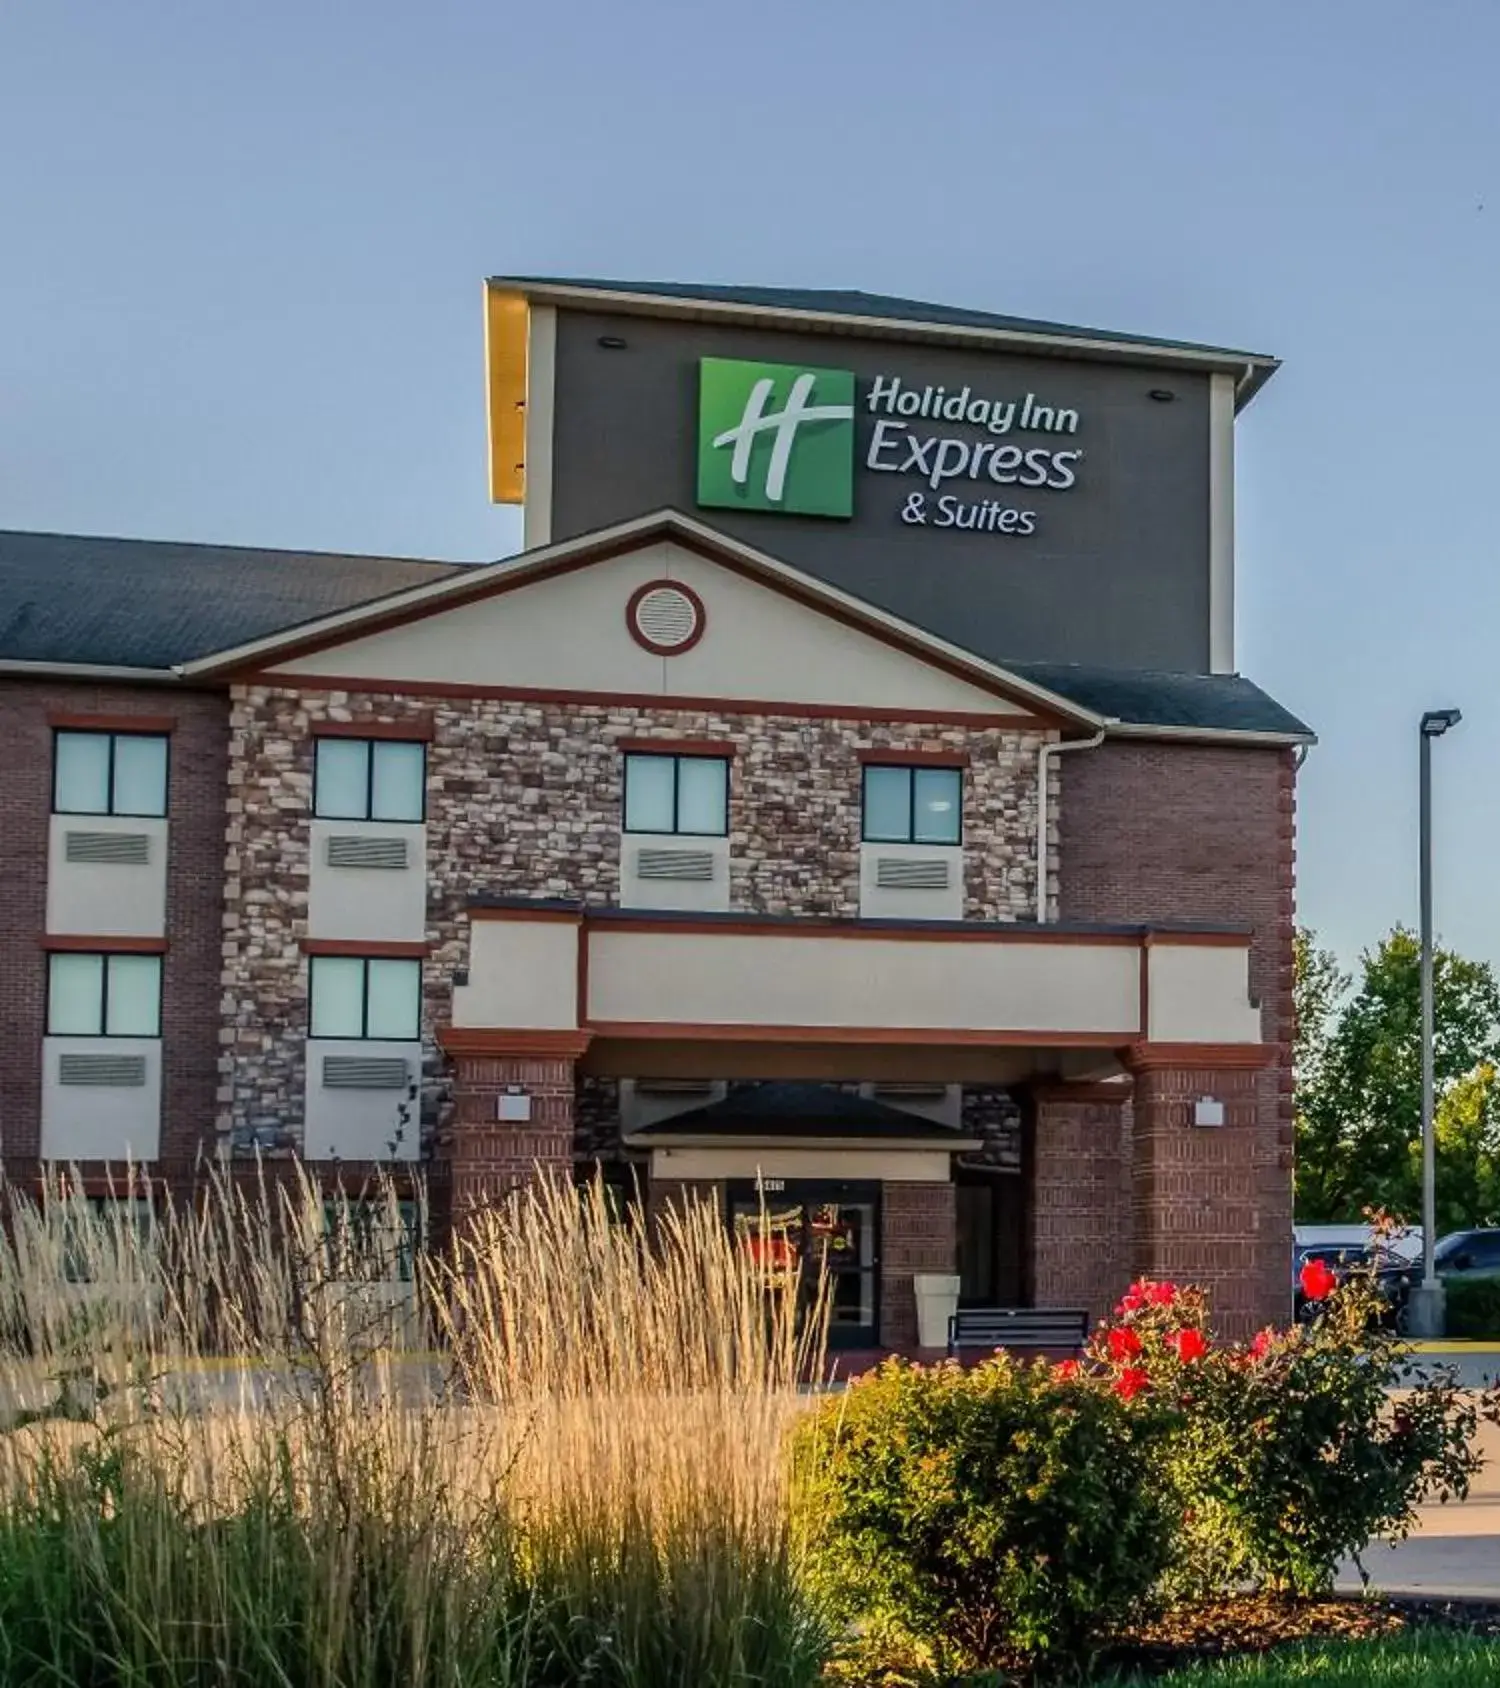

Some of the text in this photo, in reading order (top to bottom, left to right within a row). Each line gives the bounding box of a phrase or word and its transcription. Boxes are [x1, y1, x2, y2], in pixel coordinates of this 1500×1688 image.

[866, 375, 1079, 435] Holiday Inn
[866, 419, 1082, 490] Express
[902, 492, 1036, 534] & Suites
